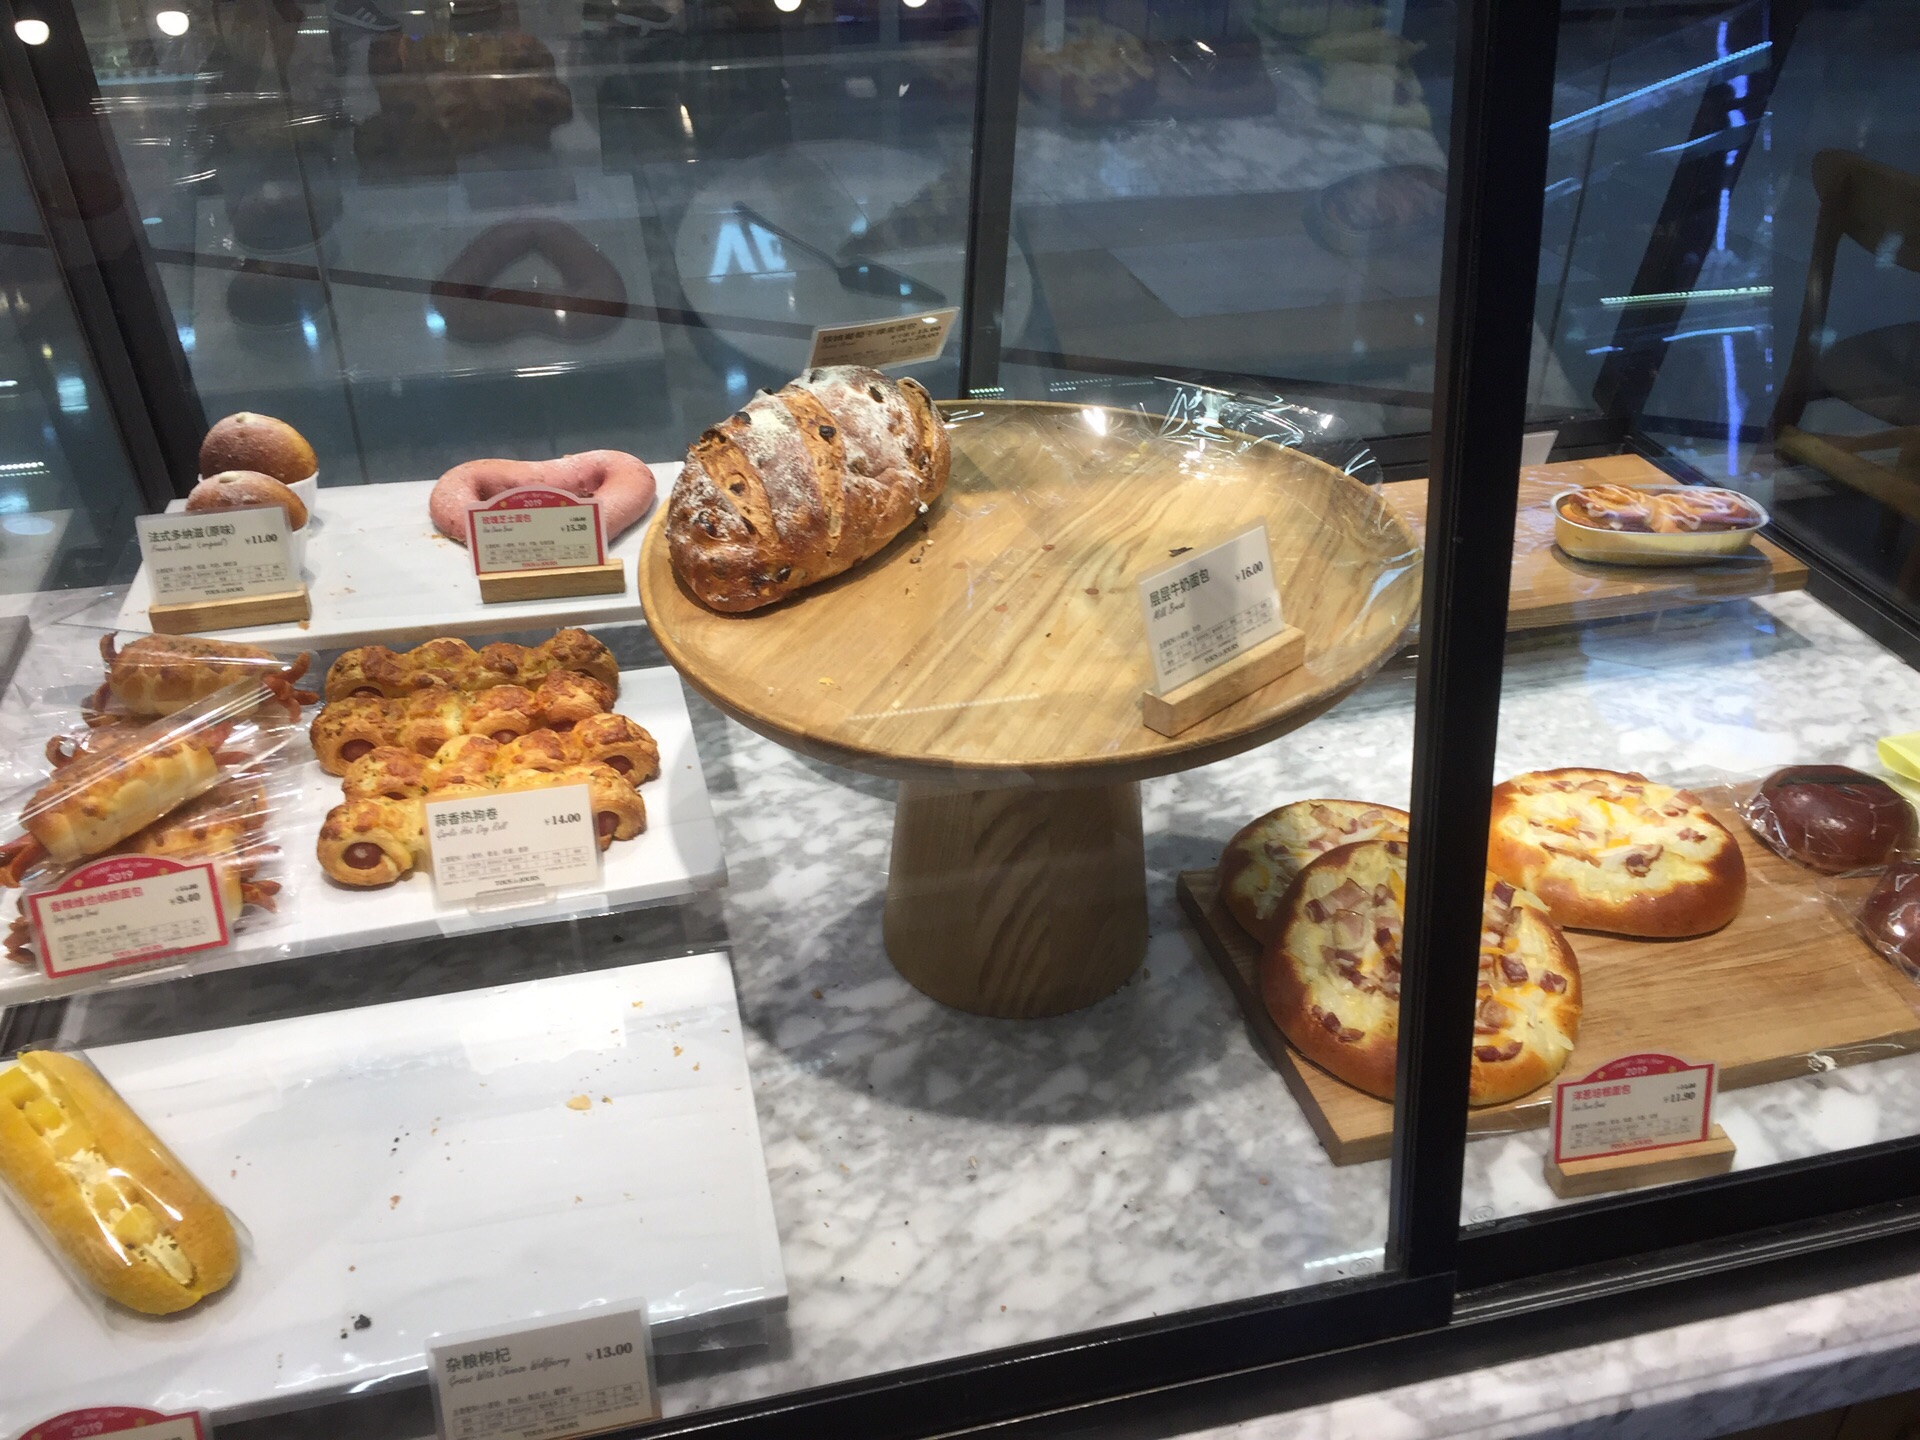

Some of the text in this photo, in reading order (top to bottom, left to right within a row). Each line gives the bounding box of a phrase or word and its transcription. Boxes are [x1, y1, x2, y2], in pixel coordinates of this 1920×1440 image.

[524, 499, 542, 507] 2019
[1150, 568, 1210, 608] 层层牛奶面包
[434, 808, 498, 826] 蒜香热狗卷
[107, 870, 134, 882] 2019
[1625, 1066, 1648, 1076] 2019
[446, 1347, 512, 1373] 杂粮枸杞
[72, 1422, 103, 1437] 2019
